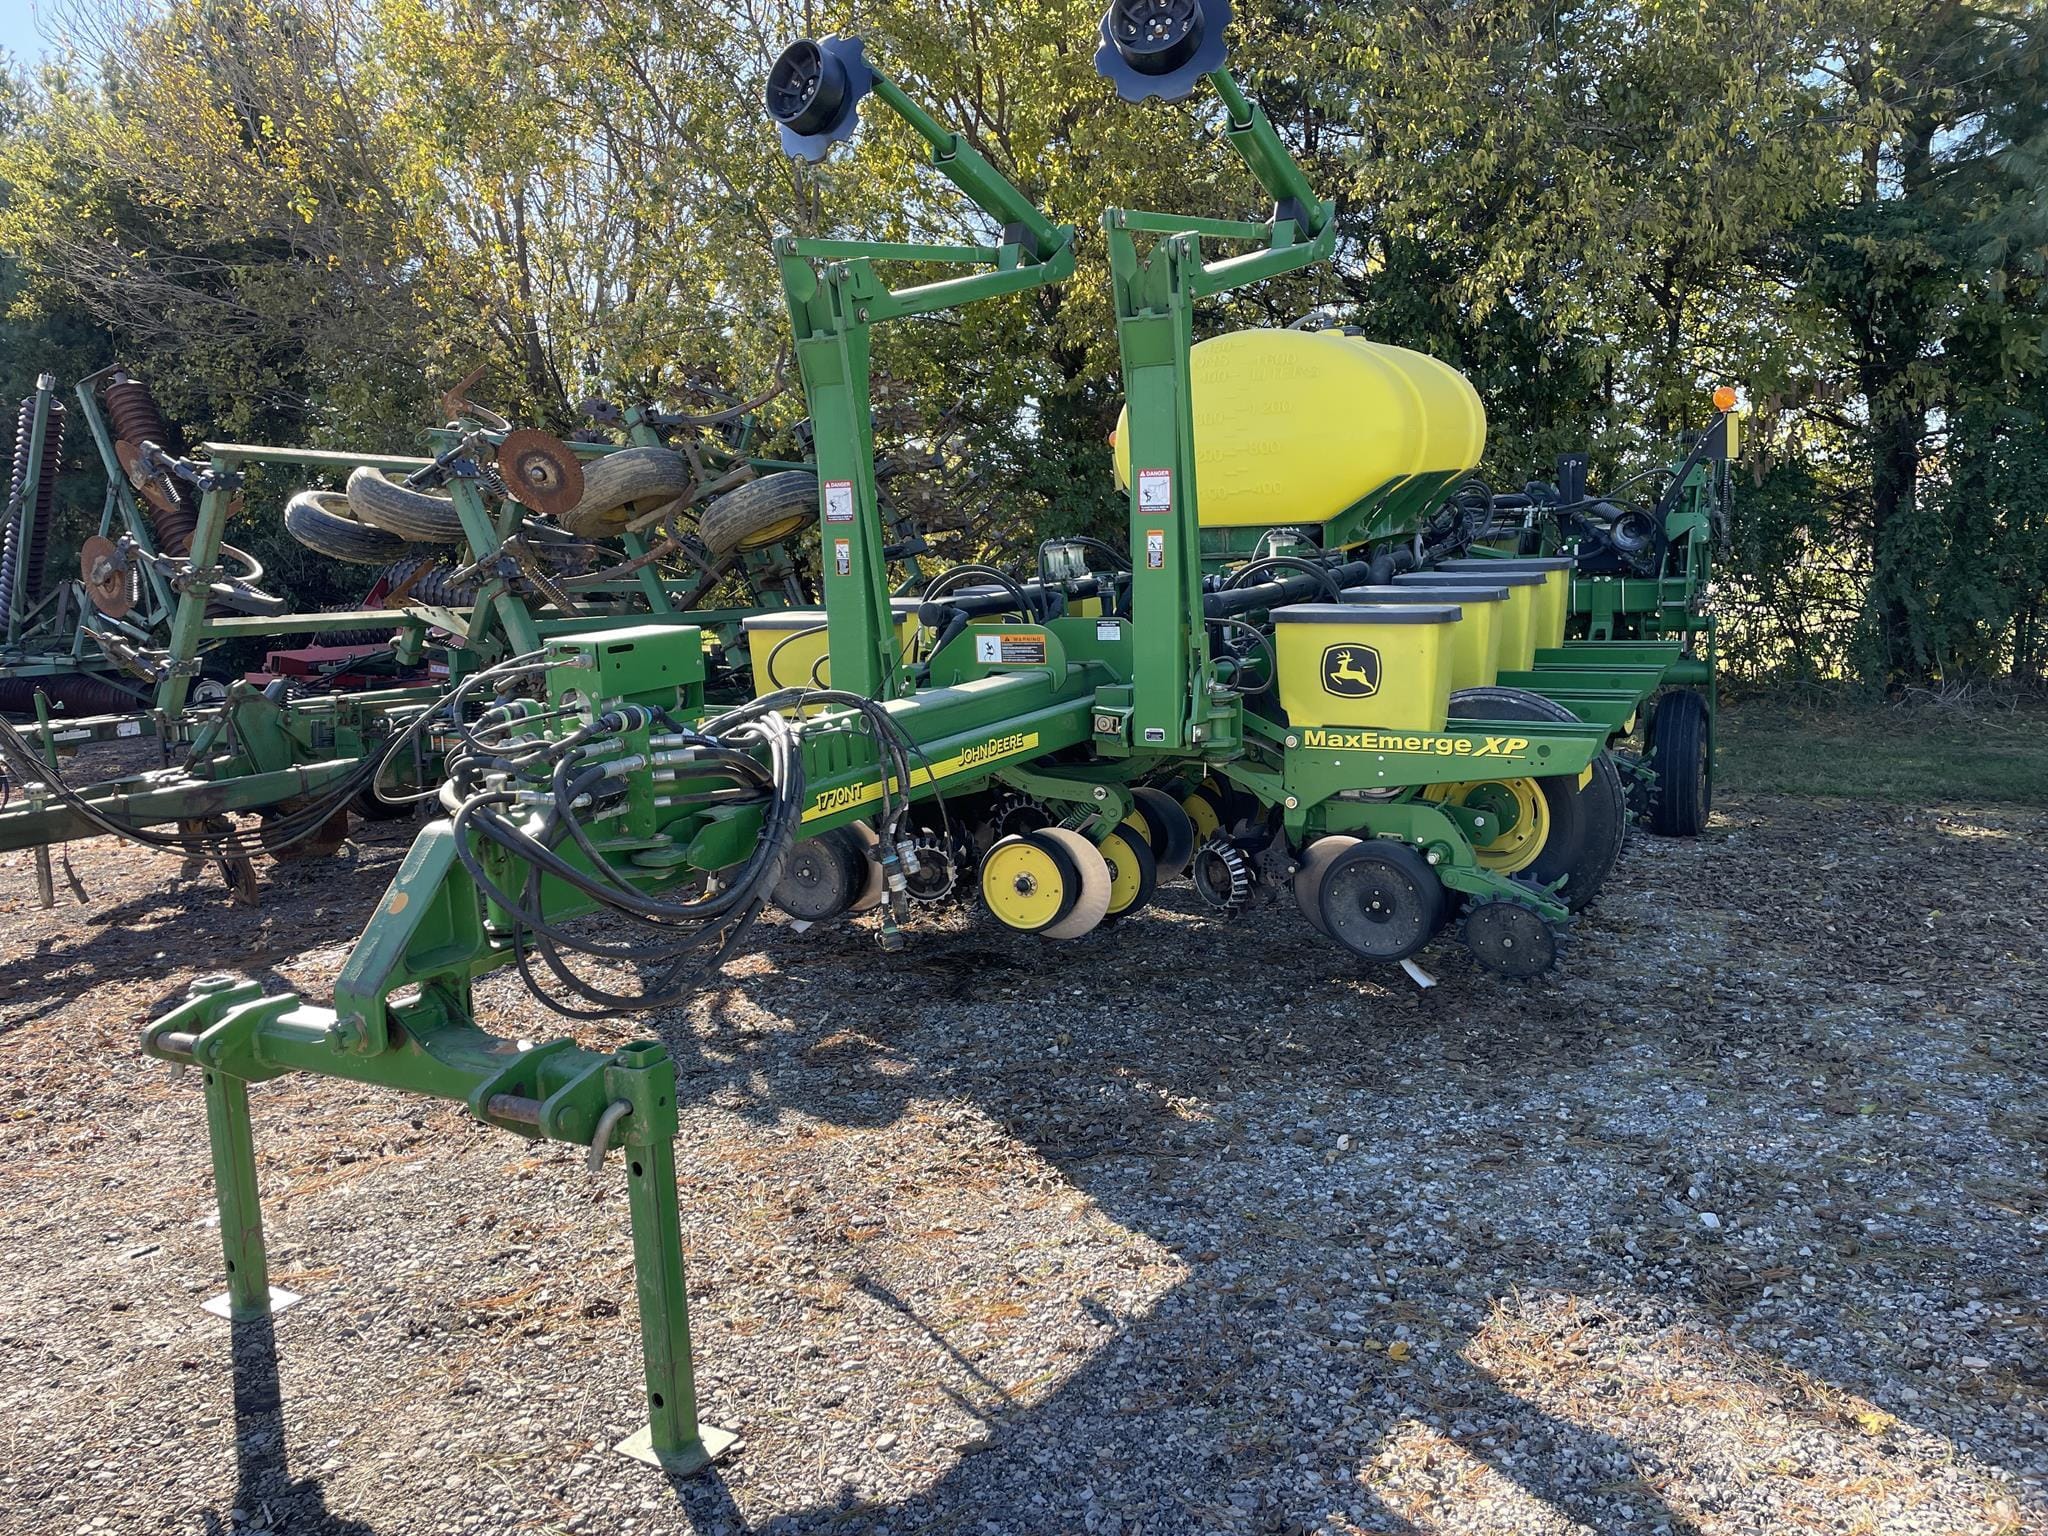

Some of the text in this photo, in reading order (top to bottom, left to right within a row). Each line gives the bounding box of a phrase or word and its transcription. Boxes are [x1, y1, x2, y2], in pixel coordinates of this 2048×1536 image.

[958, 732, 1024, 766] JOHN DEERE
[1304, 730, 1529, 757] MaxEmerge XP
[815, 781, 863, 811] 1770NT
